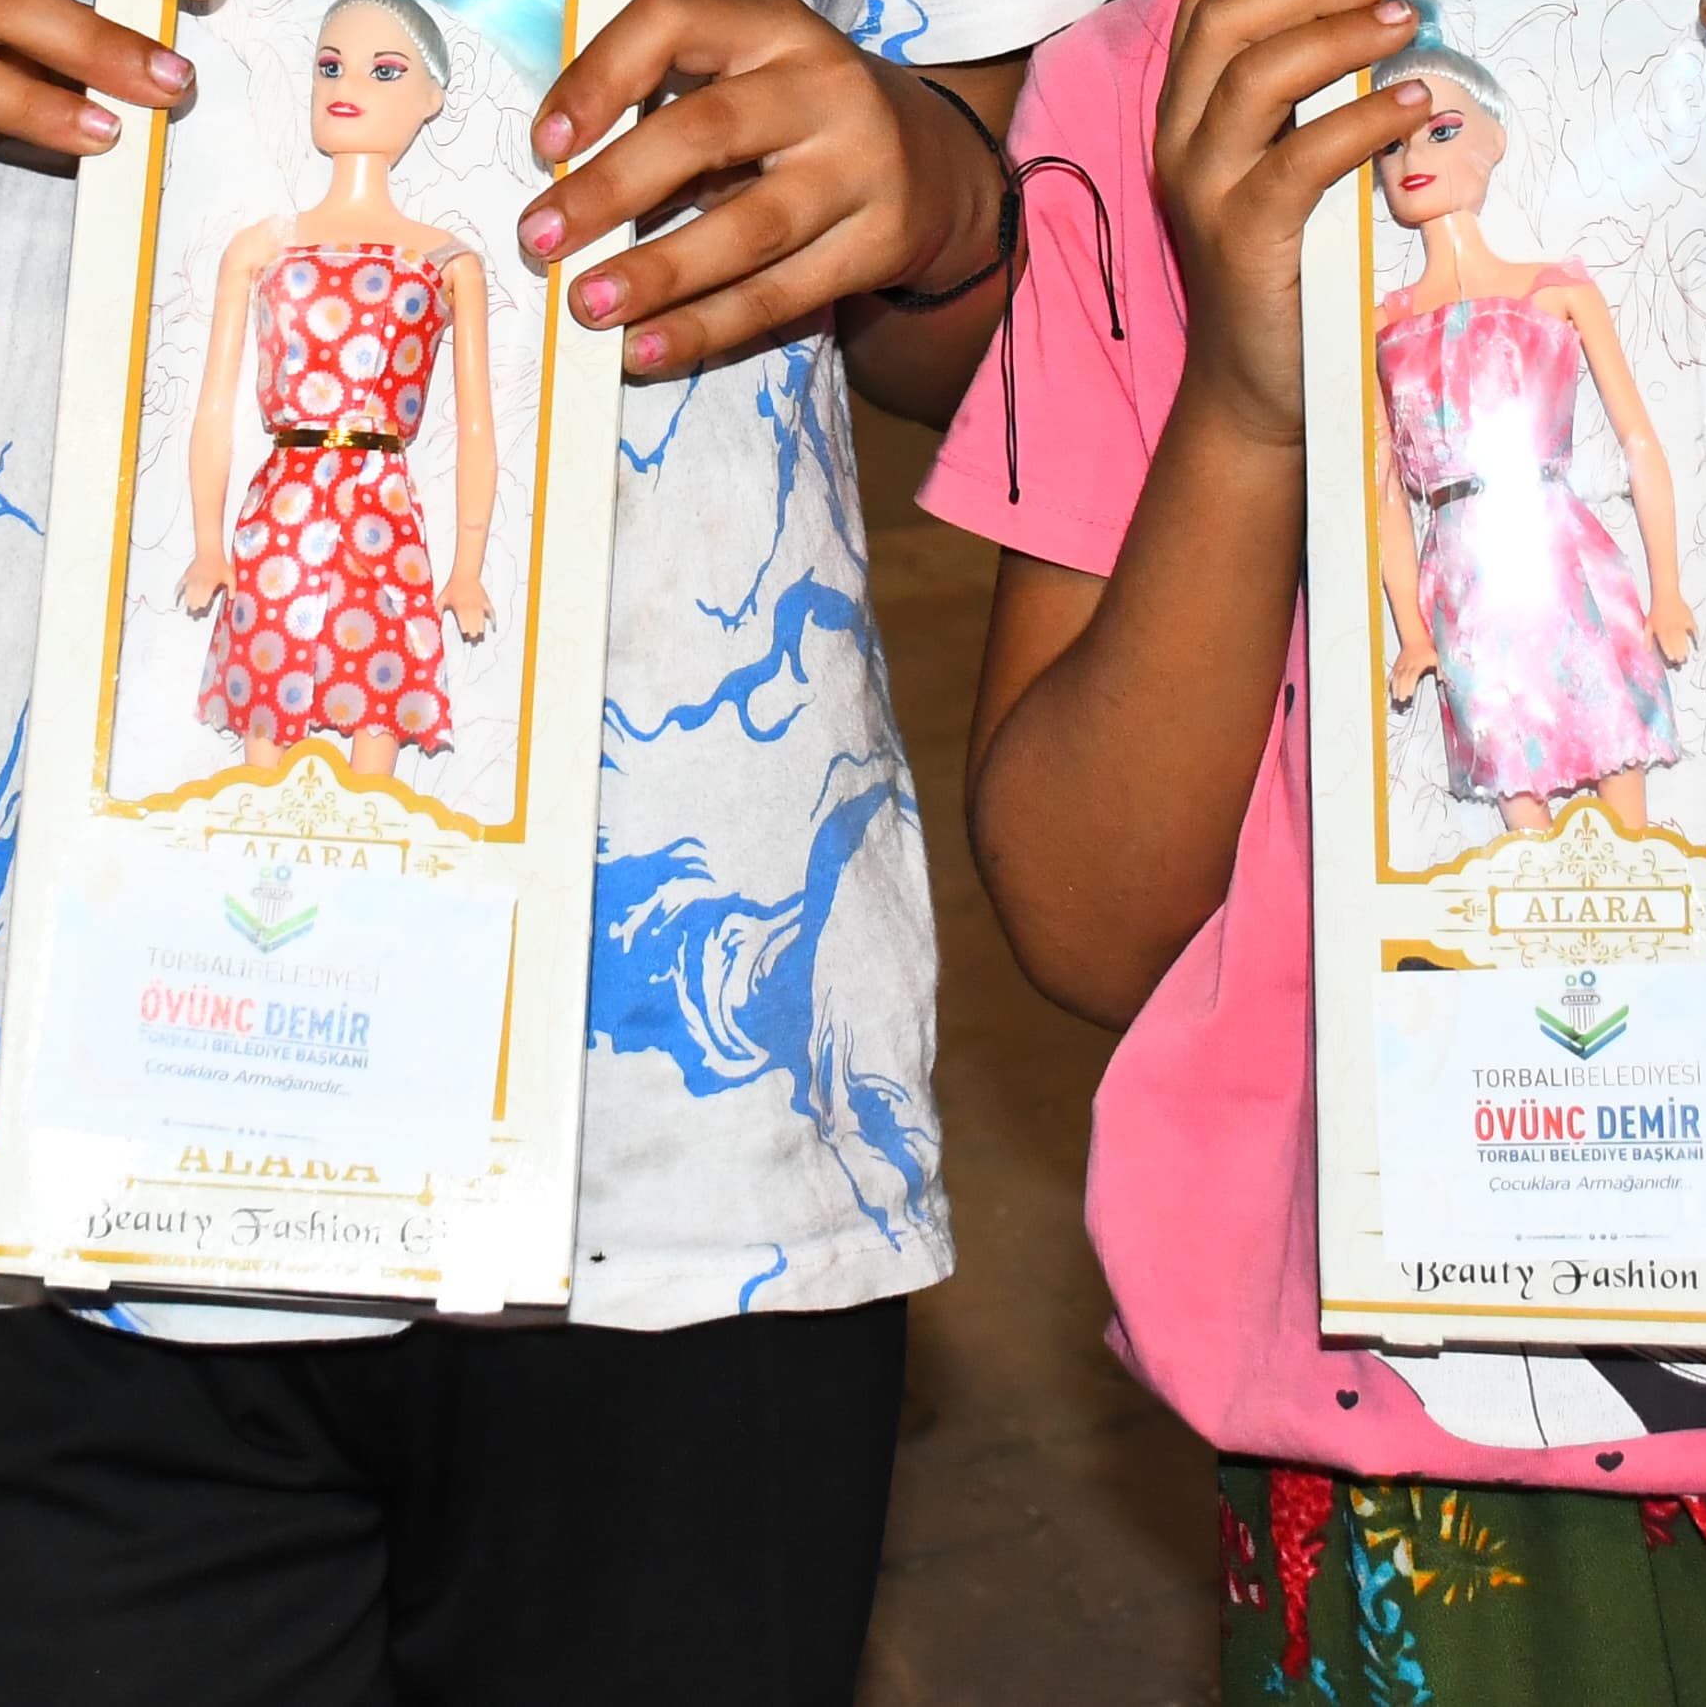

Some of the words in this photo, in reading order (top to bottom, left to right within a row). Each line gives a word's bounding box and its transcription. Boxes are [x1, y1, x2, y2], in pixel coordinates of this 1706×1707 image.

[1523, 896, 1657, 924] ALARA
[140, 977, 257, 1037] ÖVÜNÇ
[264, 1000, 371, 1047] DEMİR
[1475, 1098, 1587, 1145] ÖVÜNÇ
[1596, 1096, 1701, 1140] DEMİR
[1477, 1148, 1546, 1163] TORBALI
[1632, 1146, 1704, 1163] BAŞKANI
[1488, 1176, 1571, 1192] Çocuklara
[229, 1208, 381, 1247] Fashion
[1401, 1261, 1534, 1300] Beauty
[1551, 1260, 1698, 1296] Fashion
